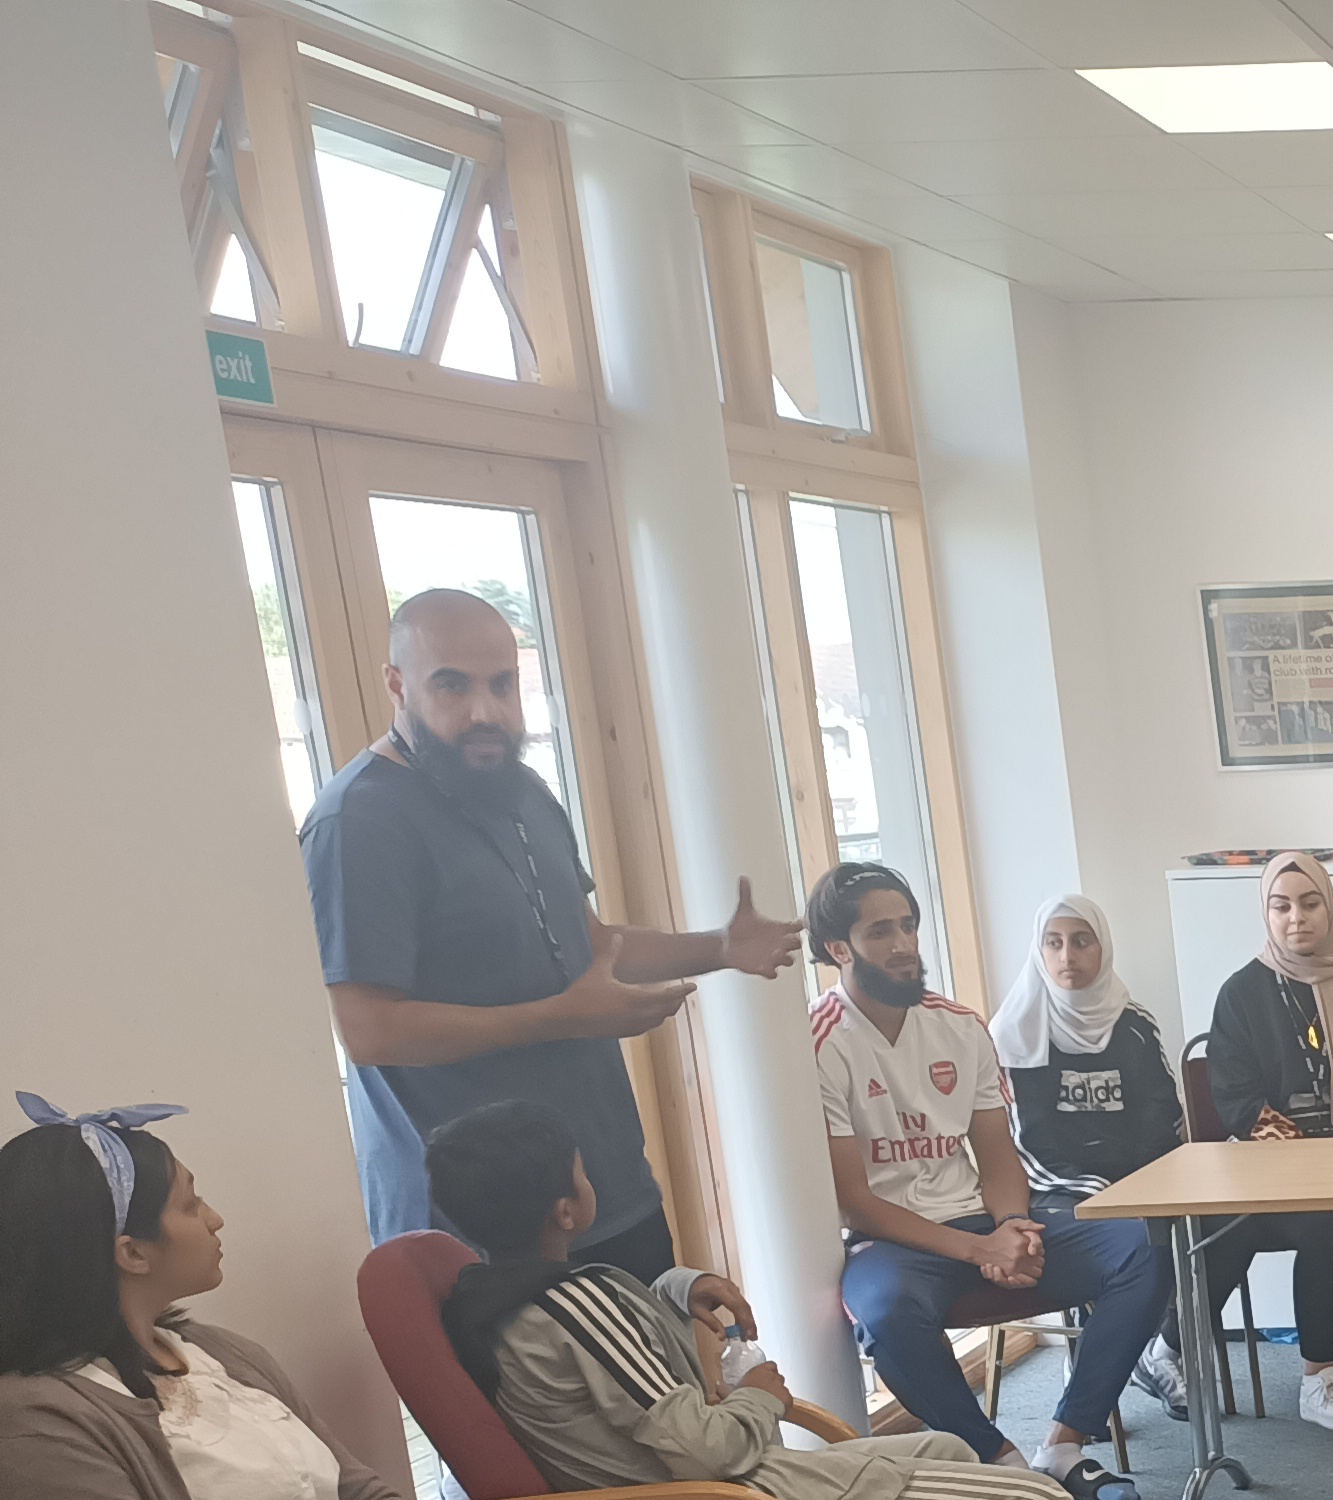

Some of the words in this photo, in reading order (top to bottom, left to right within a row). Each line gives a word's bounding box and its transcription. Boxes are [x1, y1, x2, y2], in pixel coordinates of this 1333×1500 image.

[214, 351, 256, 384] exit
[1272, 654, 1281, 664] A
[1273, 667, 1297, 677] club
[896, 1111, 926, 1132] ly
[870, 1132, 966, 1164] Emrate
